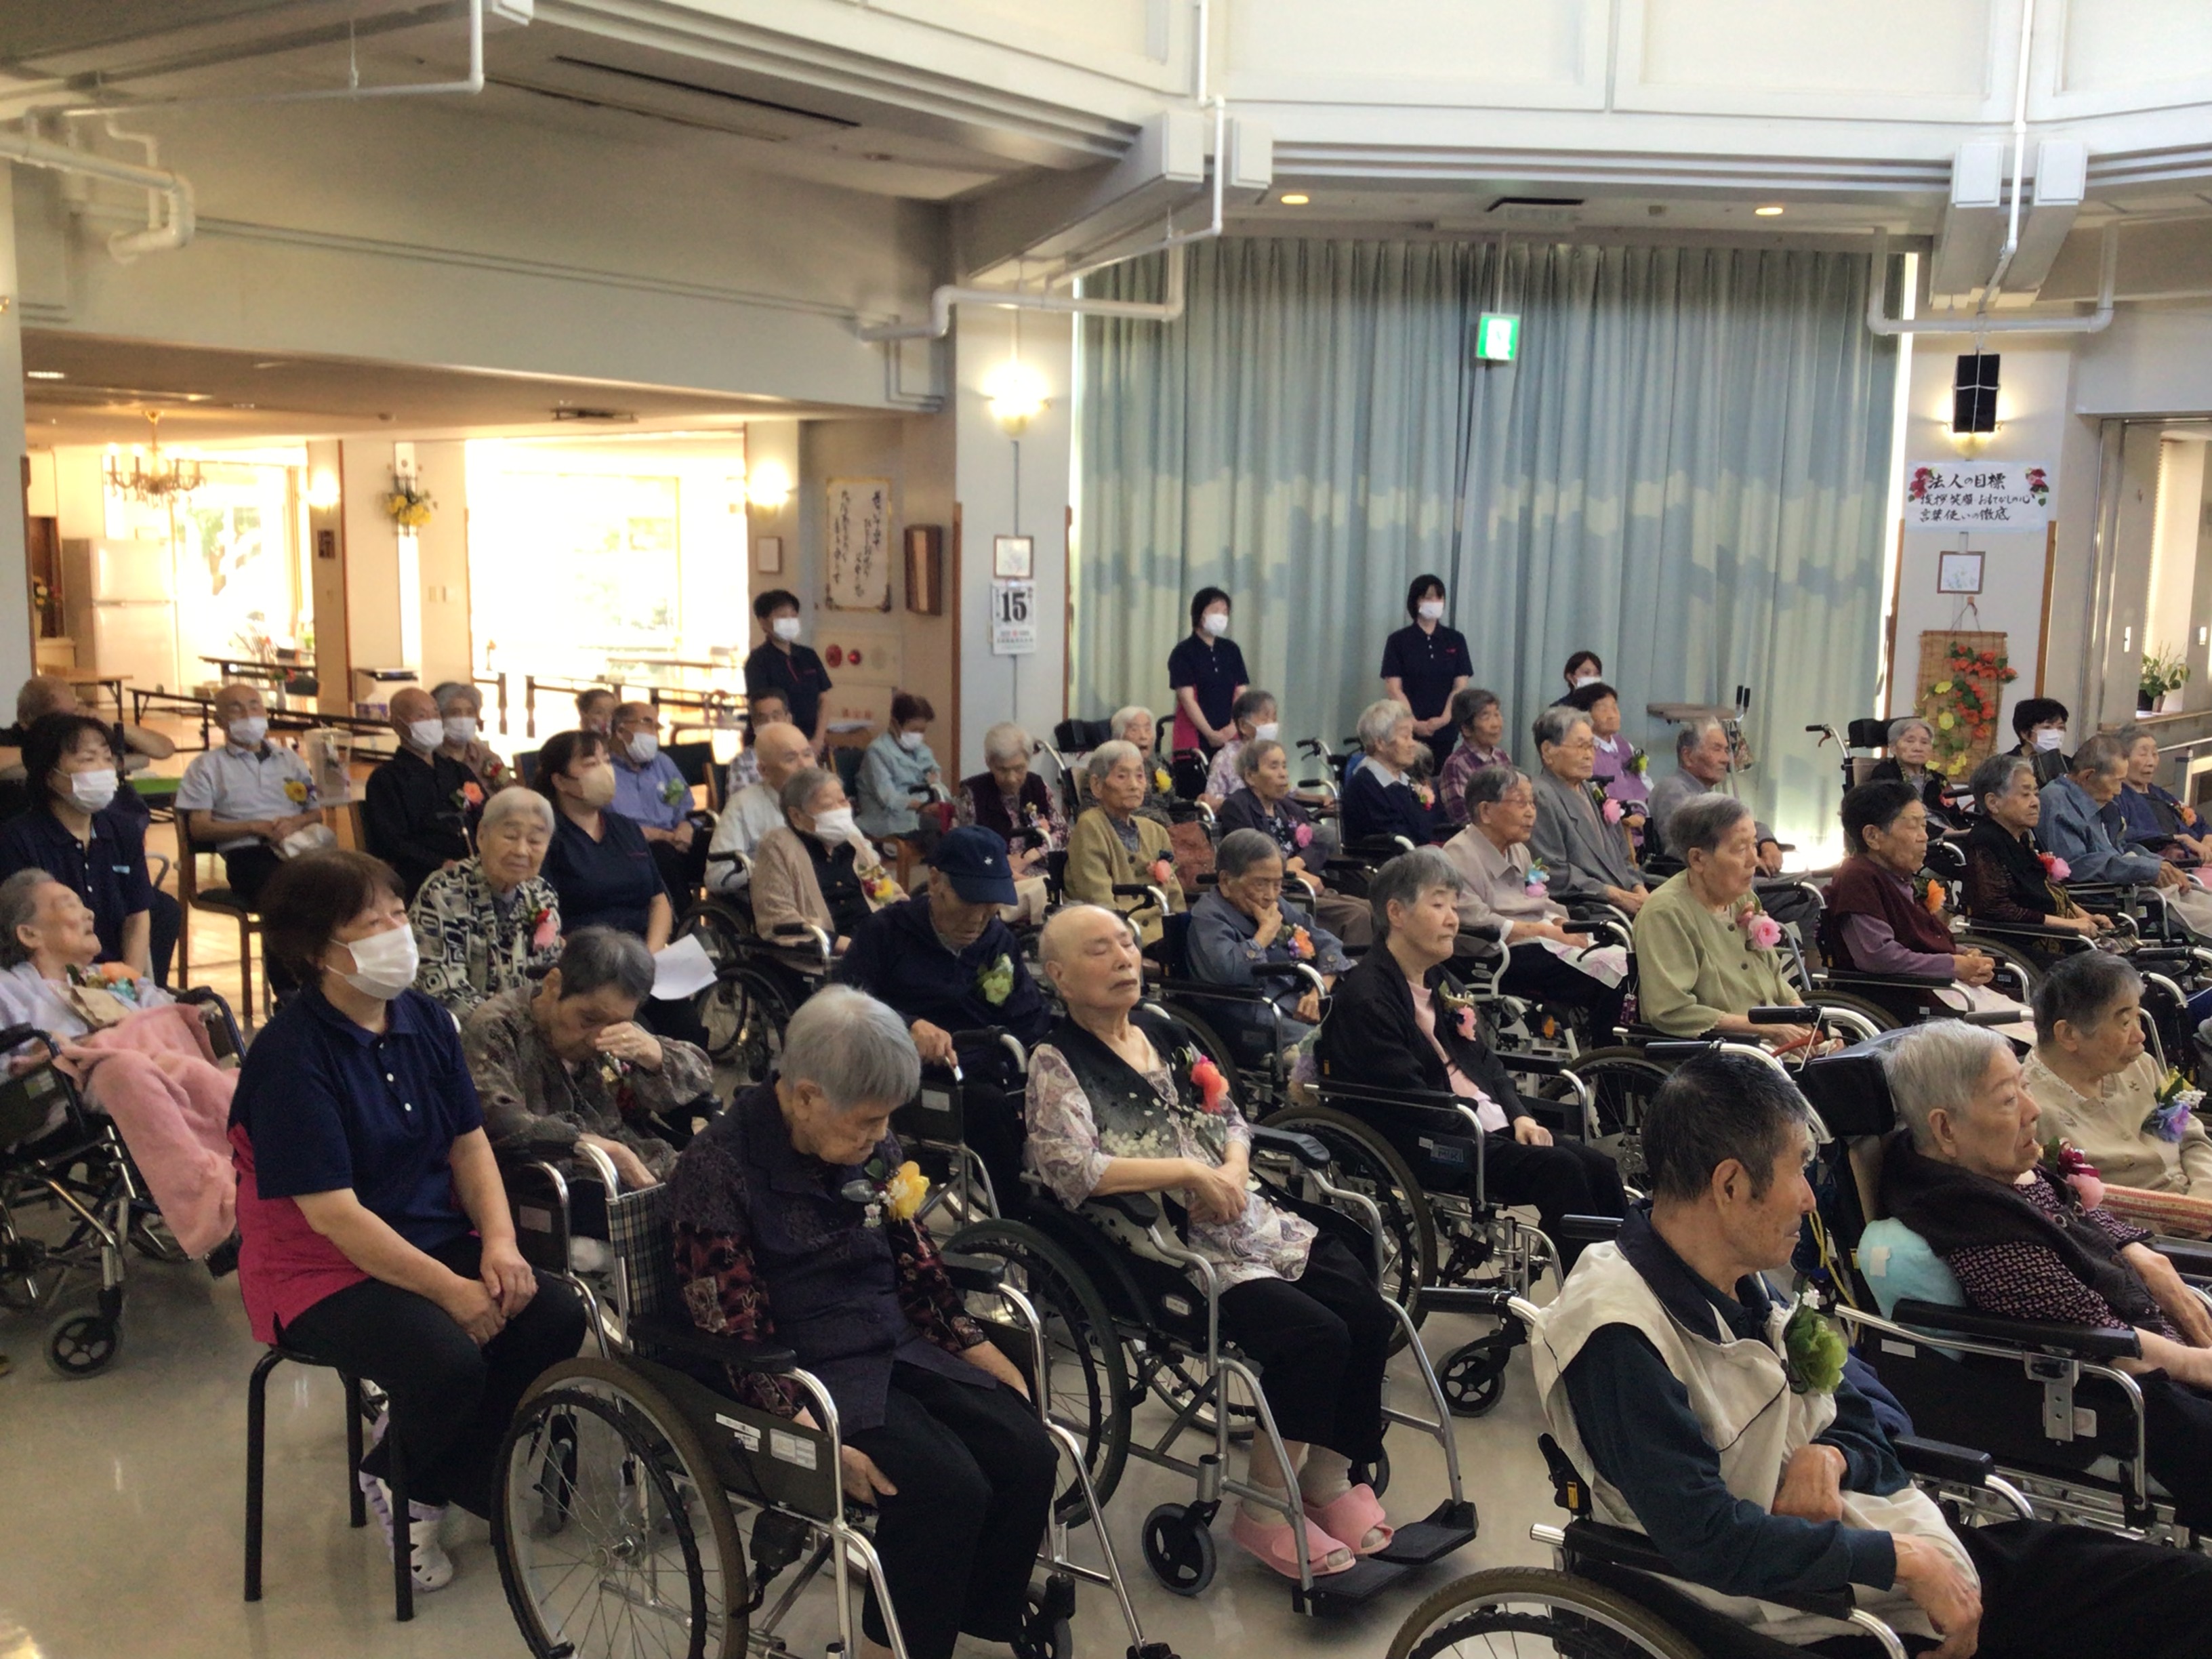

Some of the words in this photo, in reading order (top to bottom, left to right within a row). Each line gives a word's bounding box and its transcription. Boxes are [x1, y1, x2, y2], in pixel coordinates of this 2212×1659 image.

[1927, 473, 2006, 489] 法人の目標
[1002, 591, 1027, 622] 15
